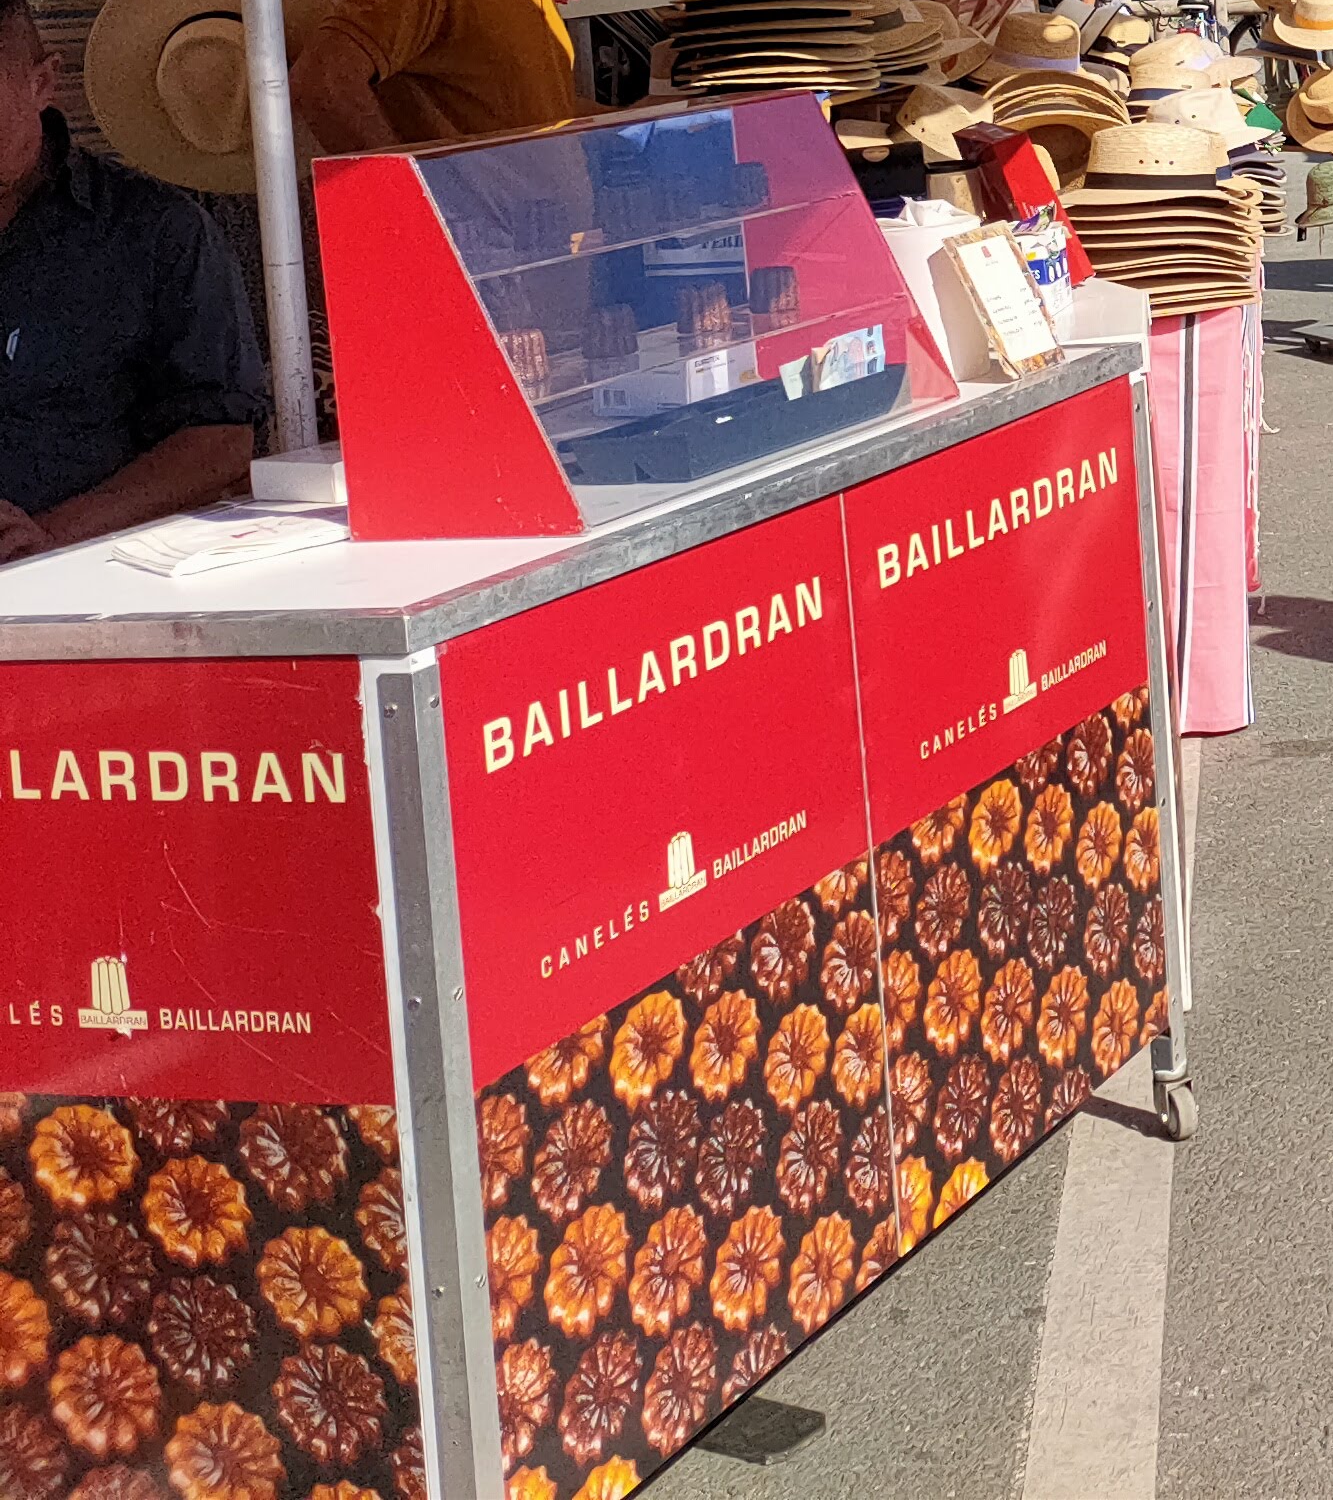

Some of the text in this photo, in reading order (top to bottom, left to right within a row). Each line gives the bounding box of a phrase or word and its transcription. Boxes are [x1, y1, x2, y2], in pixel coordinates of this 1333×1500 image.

[876, 447, 1119, 589] BAILLARDRAN
[483, 576, 823, 775] BAILLARDRAN
[919, 639, 1107, 760] CANELÉS BAILLARDRAN
[0, 749, 347, 804] LARDRAN
[540, 900, 650, 979] CANELÉS
[712, 809, 807, 880] BAILLARDRAN
[159, 1007, 312, 1034] BAILLARDRAN
